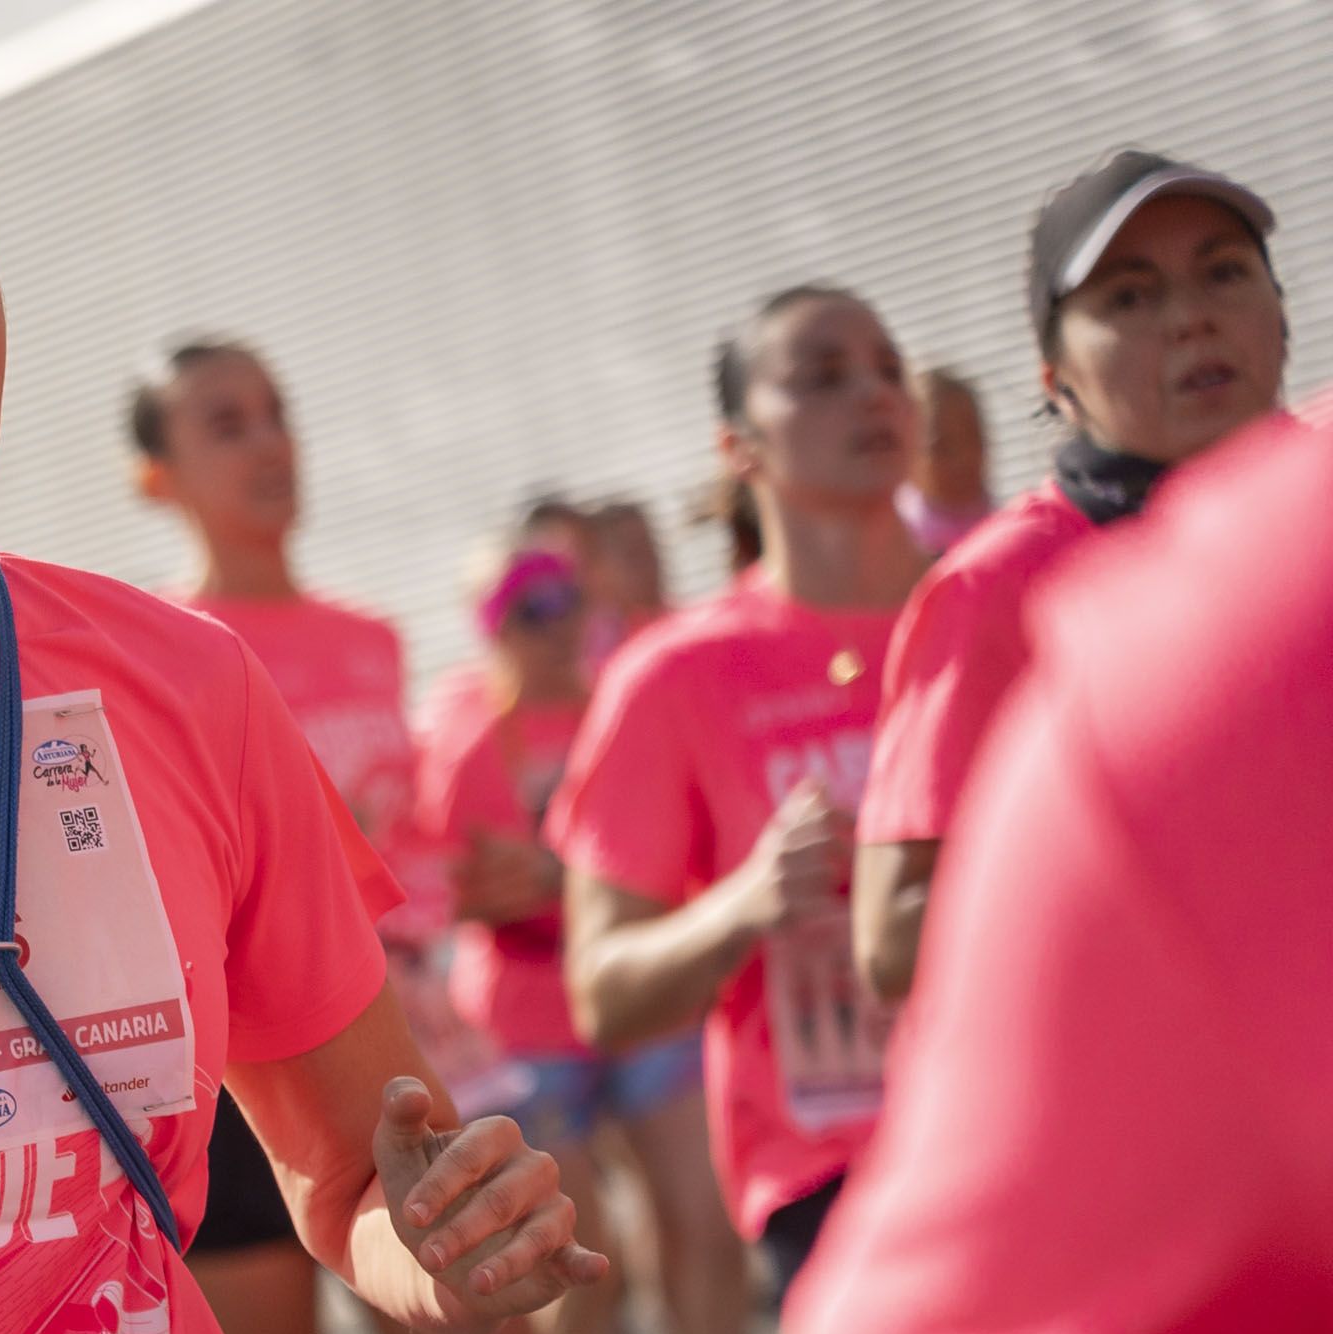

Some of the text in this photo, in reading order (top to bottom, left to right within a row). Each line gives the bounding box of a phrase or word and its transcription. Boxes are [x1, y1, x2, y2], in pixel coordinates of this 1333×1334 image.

[33, 764, 74, 779] Carrera
[75, 1011, 170, 1049] CANARIA
[101, 1077, 151, 1095] tander
